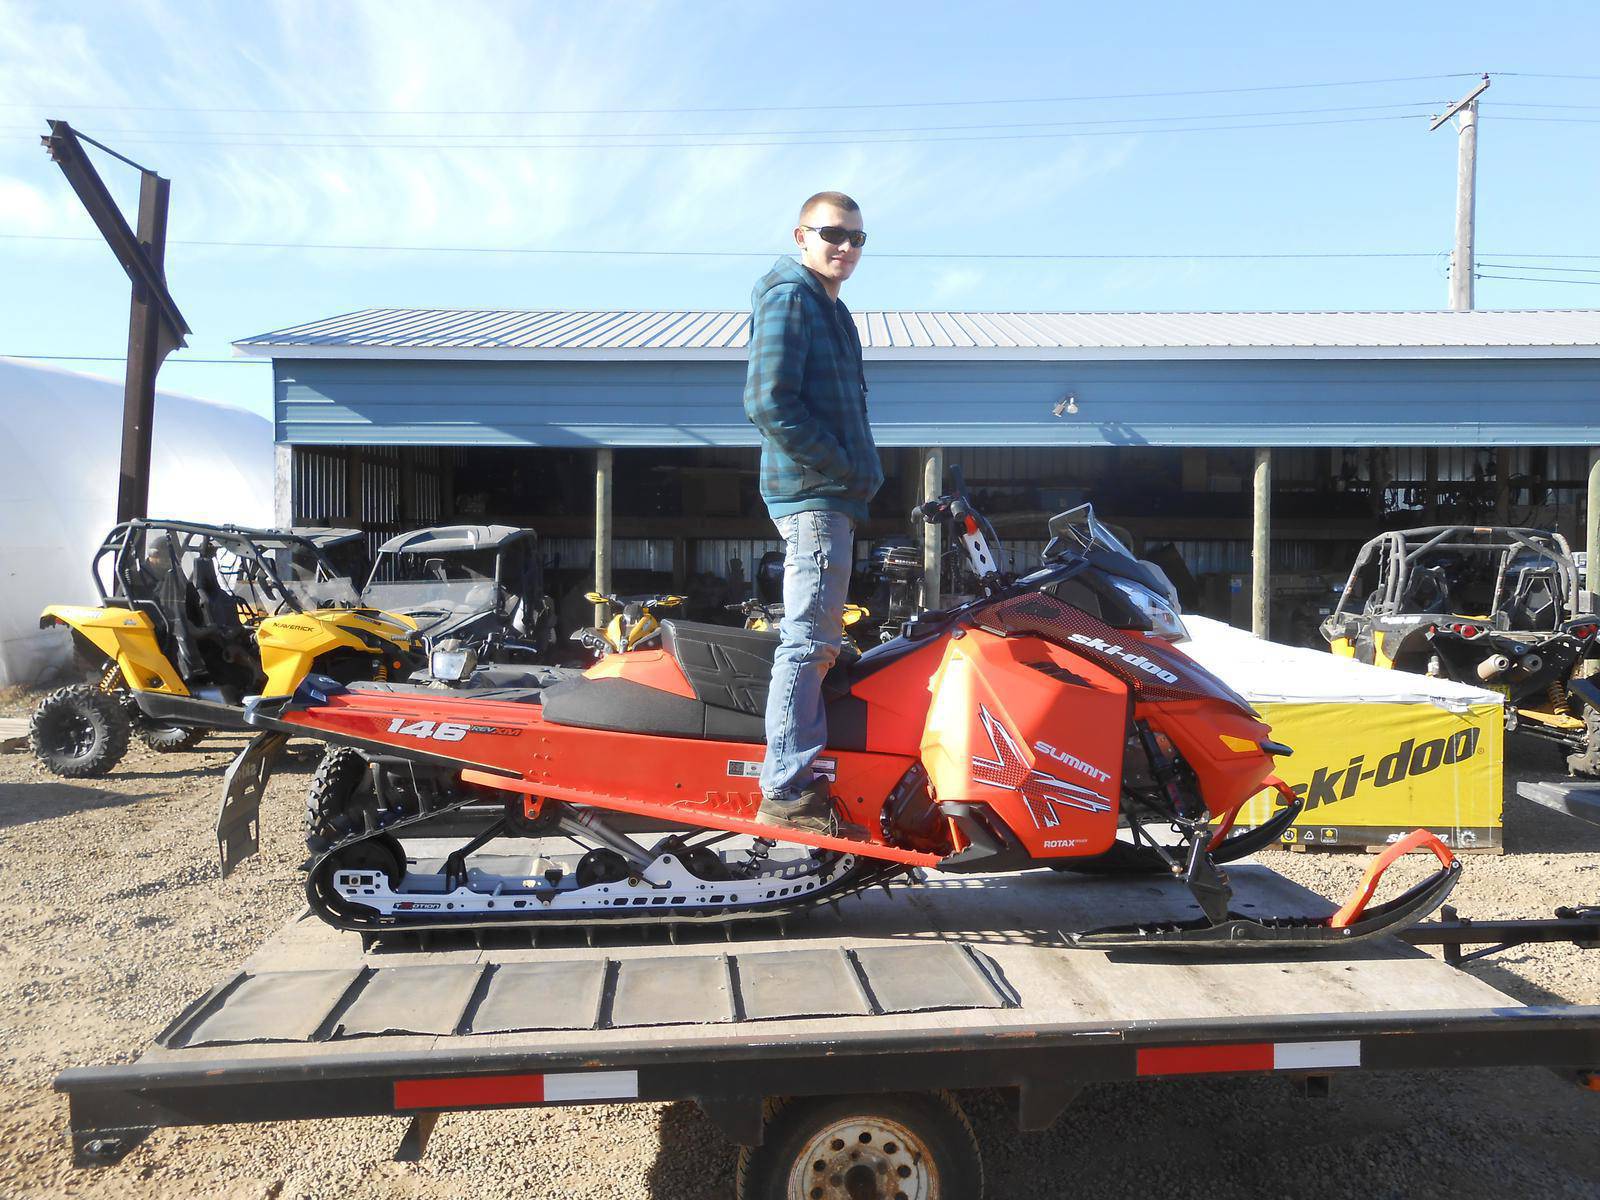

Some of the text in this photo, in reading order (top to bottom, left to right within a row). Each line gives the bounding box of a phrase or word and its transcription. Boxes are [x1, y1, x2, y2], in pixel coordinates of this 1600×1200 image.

[272, 622, 315, 633] MAVERICK
[387, 718, 471, 742] 146
[1033, 740, 1111, 783] SUMMIT
[1043, 839, 1075, 848] ROTAX
